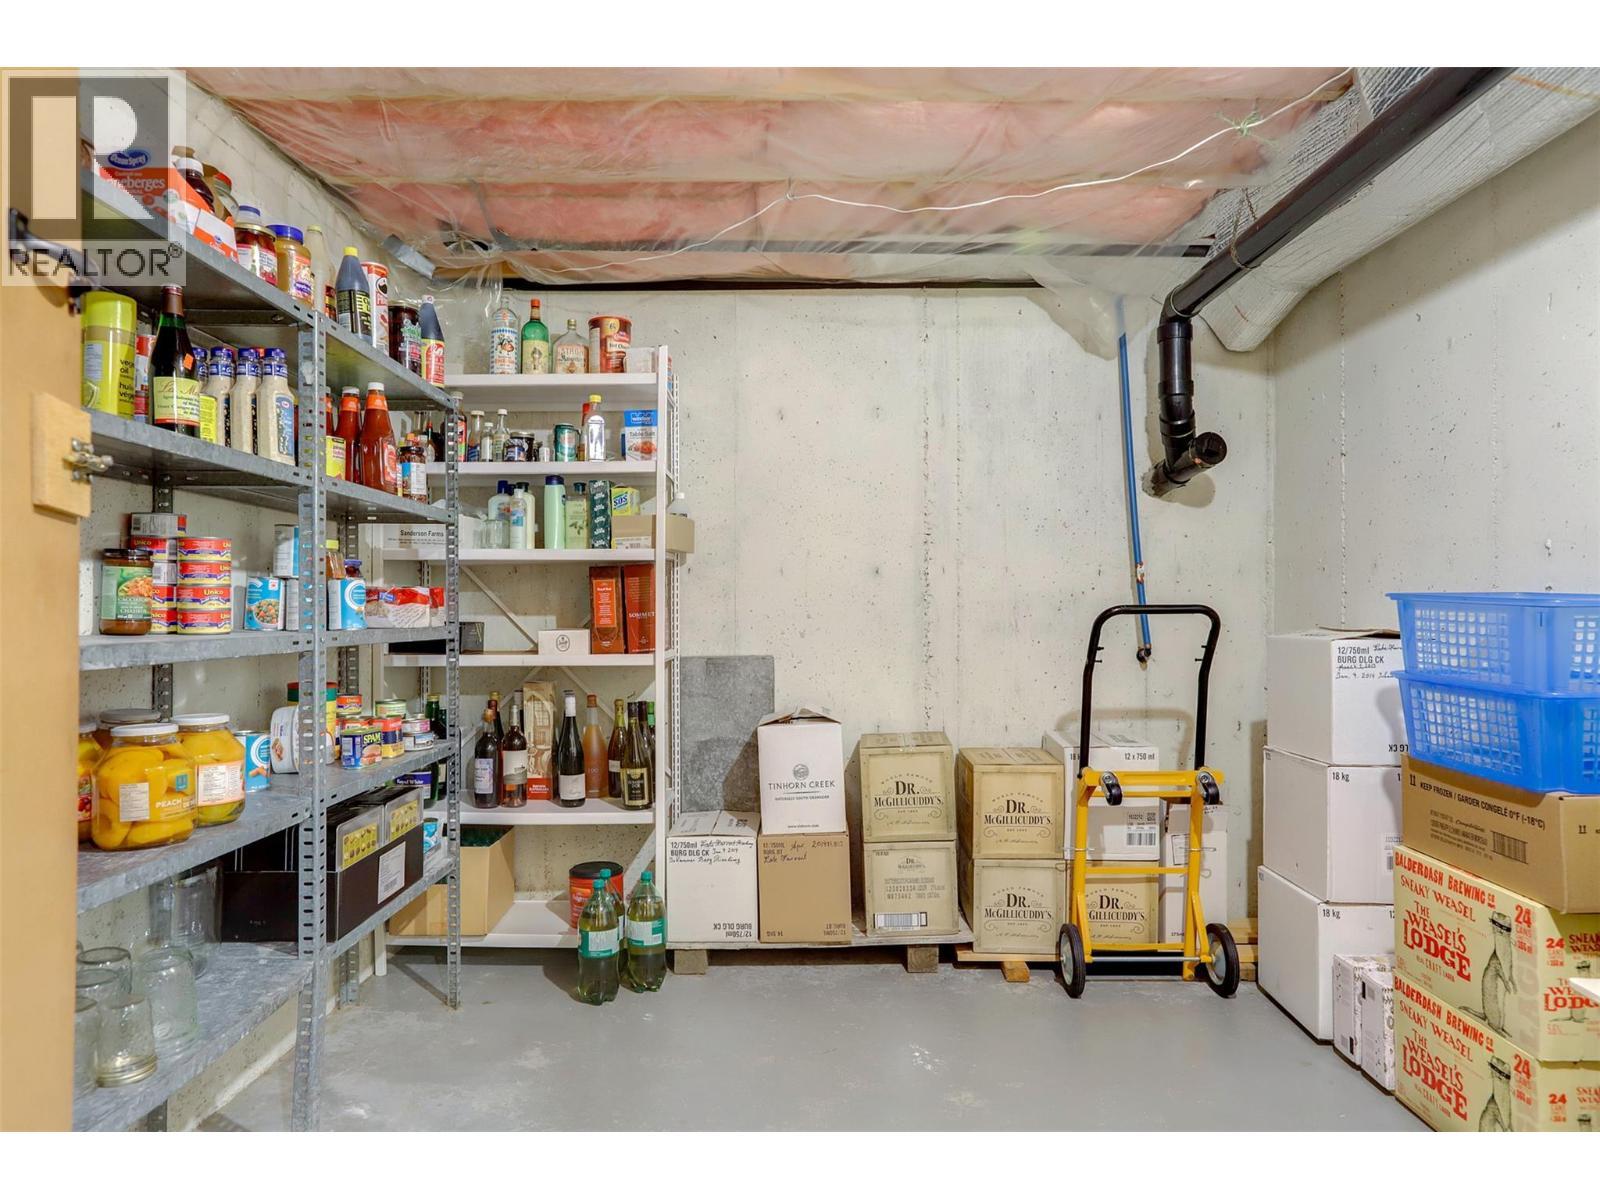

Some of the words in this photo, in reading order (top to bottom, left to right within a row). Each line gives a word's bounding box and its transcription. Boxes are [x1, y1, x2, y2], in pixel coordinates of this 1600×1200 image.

[428, 530, 445, 538] Farms
[1337, 646, 1370, 655] 12/750ml
[1337, 655, 1357, 664] BURG
[1374, 655, 1385, 664] CK
[363, 732, 381, 744] SPAM
[1124, 752, 1130, 760] 12
[1136, 752, 1147, 760] 750
[768, 781, 807, 791] TINHORN
[808, 780, 836, 789] CREEK
[1332, 772, 1341, 781] 18
[1341, 772, 1350, 783] kg
[895, 780, 920, 796] DR.
[1420, 781, 1433, 792] KEEP
[1433, 786, 1453, 799] FROZEN
[1457, 793, 1480, 808] GARDER
[155, 798, 182, 809] PEACH
[1006, 799, 1030, 814] DR.
[670, 849, 687, 857] BURG
[701, 849, 710, 857] CK
[1395, 852, 1444, 887] BALDERDASH
[1448, 875, 1486, 905] BREWING
[1006, 892, 1031, 908] DR.
[1099, 894, 1124, 910] DR.
[1400, 874, 1430, 899] SNEAKY
[1432, 889, 1476, 922] WEASEL
[1322, 908, 1331, 918] 18
[1332, 909, 1341, 919] kg
[1413, 900, 1430, 919] THE
[1515, 904, 1532, 928] 24
[1404, 909, 1467, 954] WEASEL'S
[1403, 918, 1472, 982] LODGE
[1545, 937, 1565, 949] 24
[1394, 975, 1442, 1018] BALDERDASH
[1446, 1010, 1484, 1047] BREWING
[1399, 1000, 1428, 1030] SNEAKY
[1430, 1021, 1473, 1063] WEASEL
[1412, 1028, 1428, 1050] THE
[1404, 1035, 1464, 1092] WEASEL'S
[1513, 1053, 1532, 1080] 24
[1402, 1044, 1468, 1121] LODGE
[1548, 1093, 1567, 1105] 24
